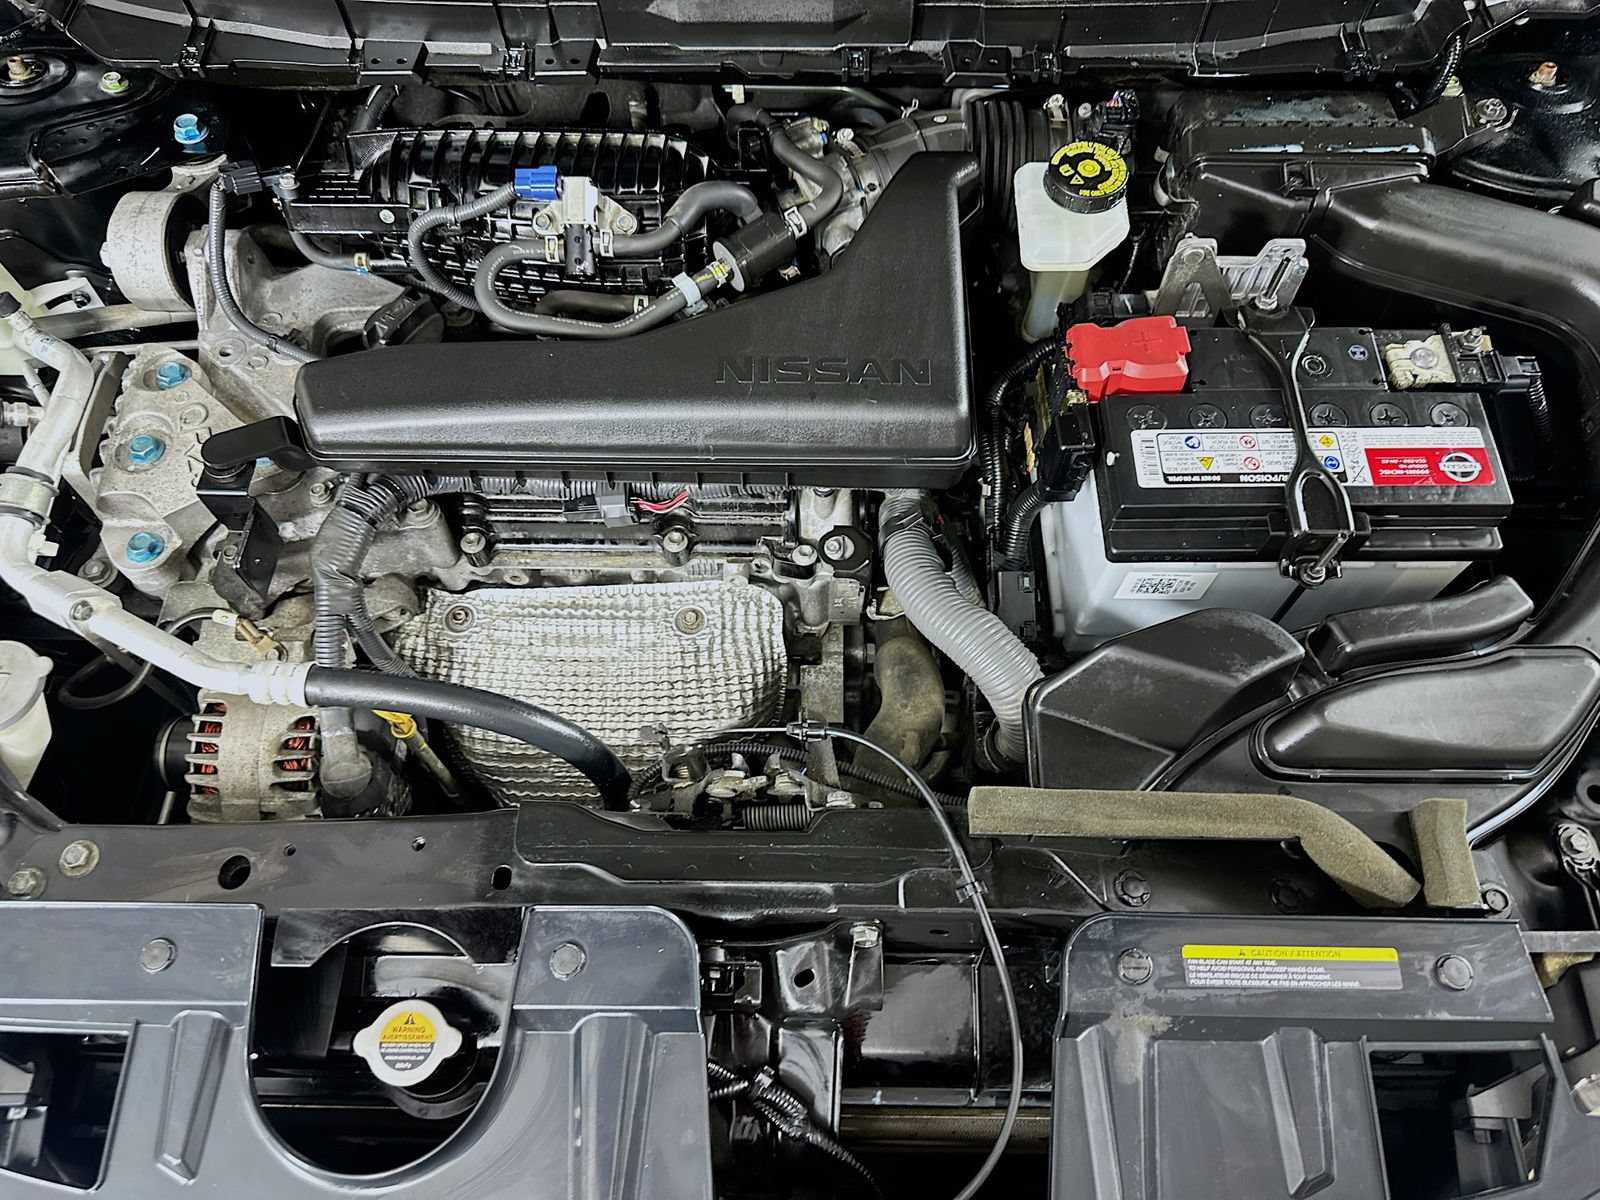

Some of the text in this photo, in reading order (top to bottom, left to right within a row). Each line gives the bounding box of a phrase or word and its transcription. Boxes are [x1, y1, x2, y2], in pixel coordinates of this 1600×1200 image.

[715, 356, 932, 386] NISSAN
[1239, 474, 1288, 482] R/POISON
[1250, 949, 1287, 957] CAUTION
[1296, 950, 1341, 958] ATTENTION
